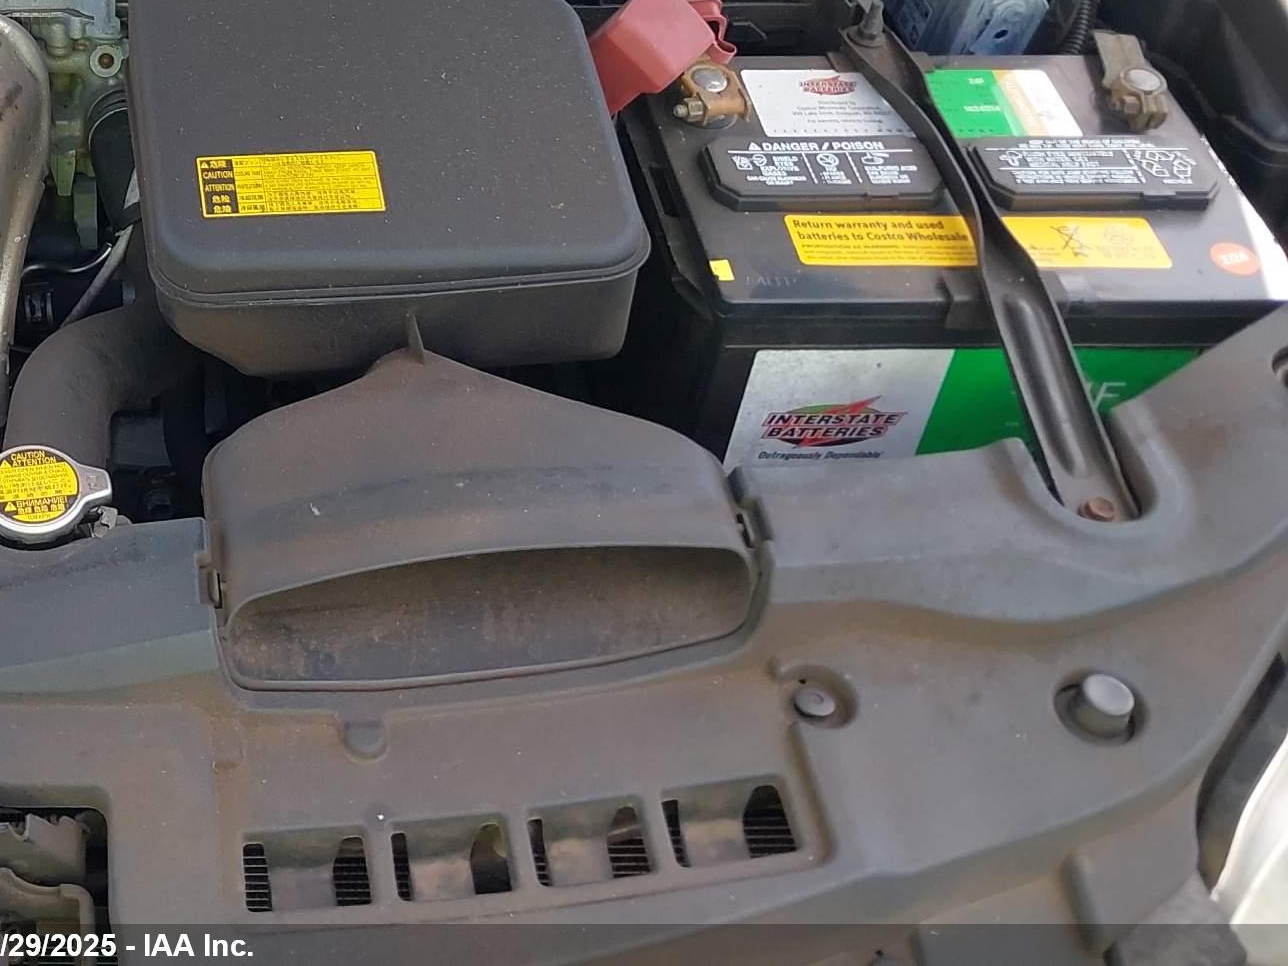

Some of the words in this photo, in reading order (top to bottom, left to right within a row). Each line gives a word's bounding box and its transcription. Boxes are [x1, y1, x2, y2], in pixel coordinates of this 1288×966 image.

[762, 142, 819, 150] DANGER
[832, 141, 885, 150] POISON
[203, 170, 233, 180] CAUTION
[204, 184, 234, 192] ATTENTION
[793, 220, 832, 229] Return
[836, 220, 888, 230] warranty
[892, 220, 912, 229] and
[916, 220, 944, 230] used
[798, 230, 849, 240] batteries
[852, 232, 864, 240] to
[866, 232, 904, 241] Costco
[908, 232, 968, 242] Wholesale
[766, 413, 899, 426] INTERSTATE
[767, 426, 884, 438] BATTERIES
[11, 451, 45, 461] CAUTION
[758, 451, 822, 460] Outrageously
[825, 451, 882, 460] Dependable
[12, 457, 56, 467] ATTENTION
[16, 496, 67, 507] ВНИМАНИЕ!
